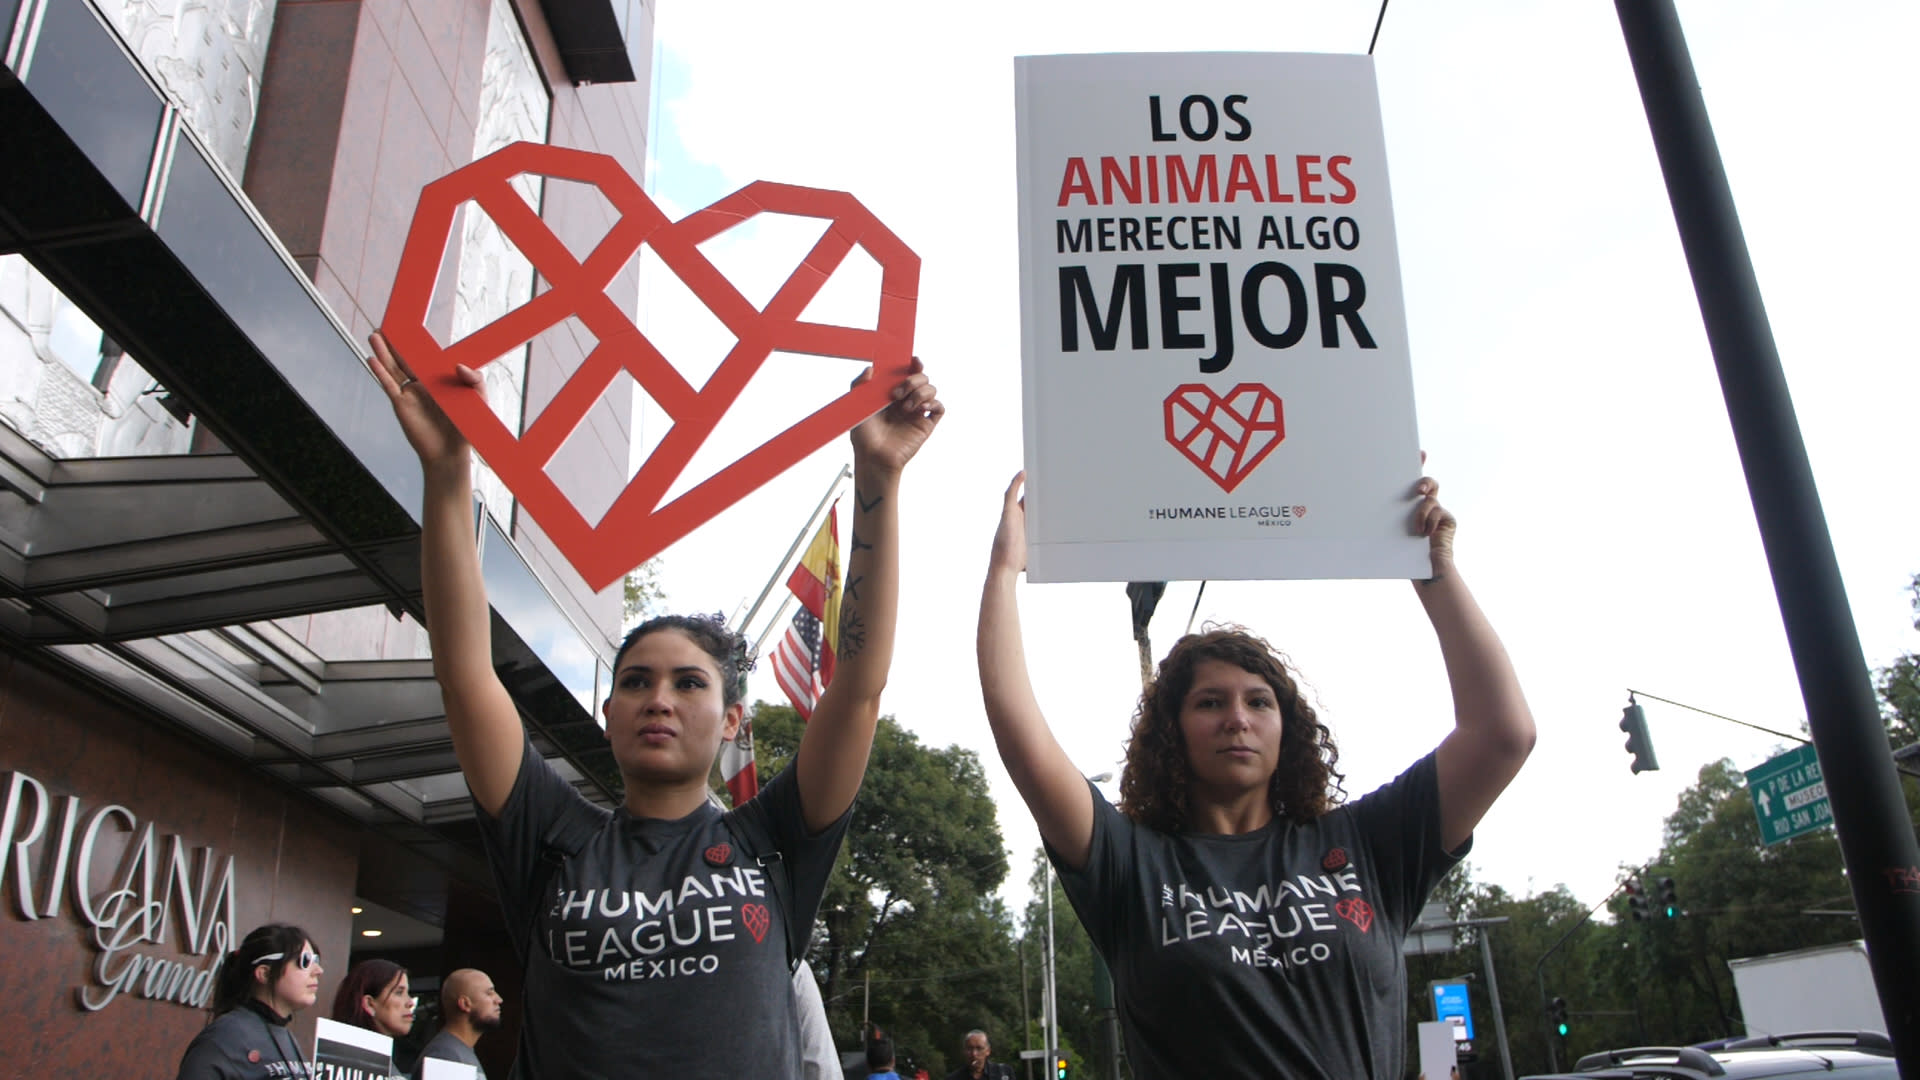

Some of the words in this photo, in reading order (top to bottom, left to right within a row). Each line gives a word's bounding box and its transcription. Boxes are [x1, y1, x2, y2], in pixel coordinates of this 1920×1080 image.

[1149, 94, 1252, 142] LOS
[1057, 154, 1357, 206] ANIMALES
[1056, 216, 1242, 253] MERECEN
[1257, 216, 1360, 251] ALGO
[1058, 261, 1378, 374] MEJOR
[1156, 507, 1226, 519] HUMANE
[1230, 506, 1291, 518] LEAGUE
[1777, 776, 1791, 793] DE
[1791, 771, 1805, 787] LA
[1788, 784, 1824, 805] MUSEO
[1773, 817, 1790, 835] RIO
[1792, 809, 1811, 829] SAN
[0, 771, 236, 954] RICANA
[562, 866, 765, 920] HUMANE
[1179, 862, 1361, 913] HUMANE
[549, 905, 735, 966] LEAGUE
[1162, 903, 1336, 949] LEAGUE
[82, 889, 227, 1011] Grand
[604, 954, 719, 981] MÉXICO
[1231, 943, 1330, 968] MÉXICO
